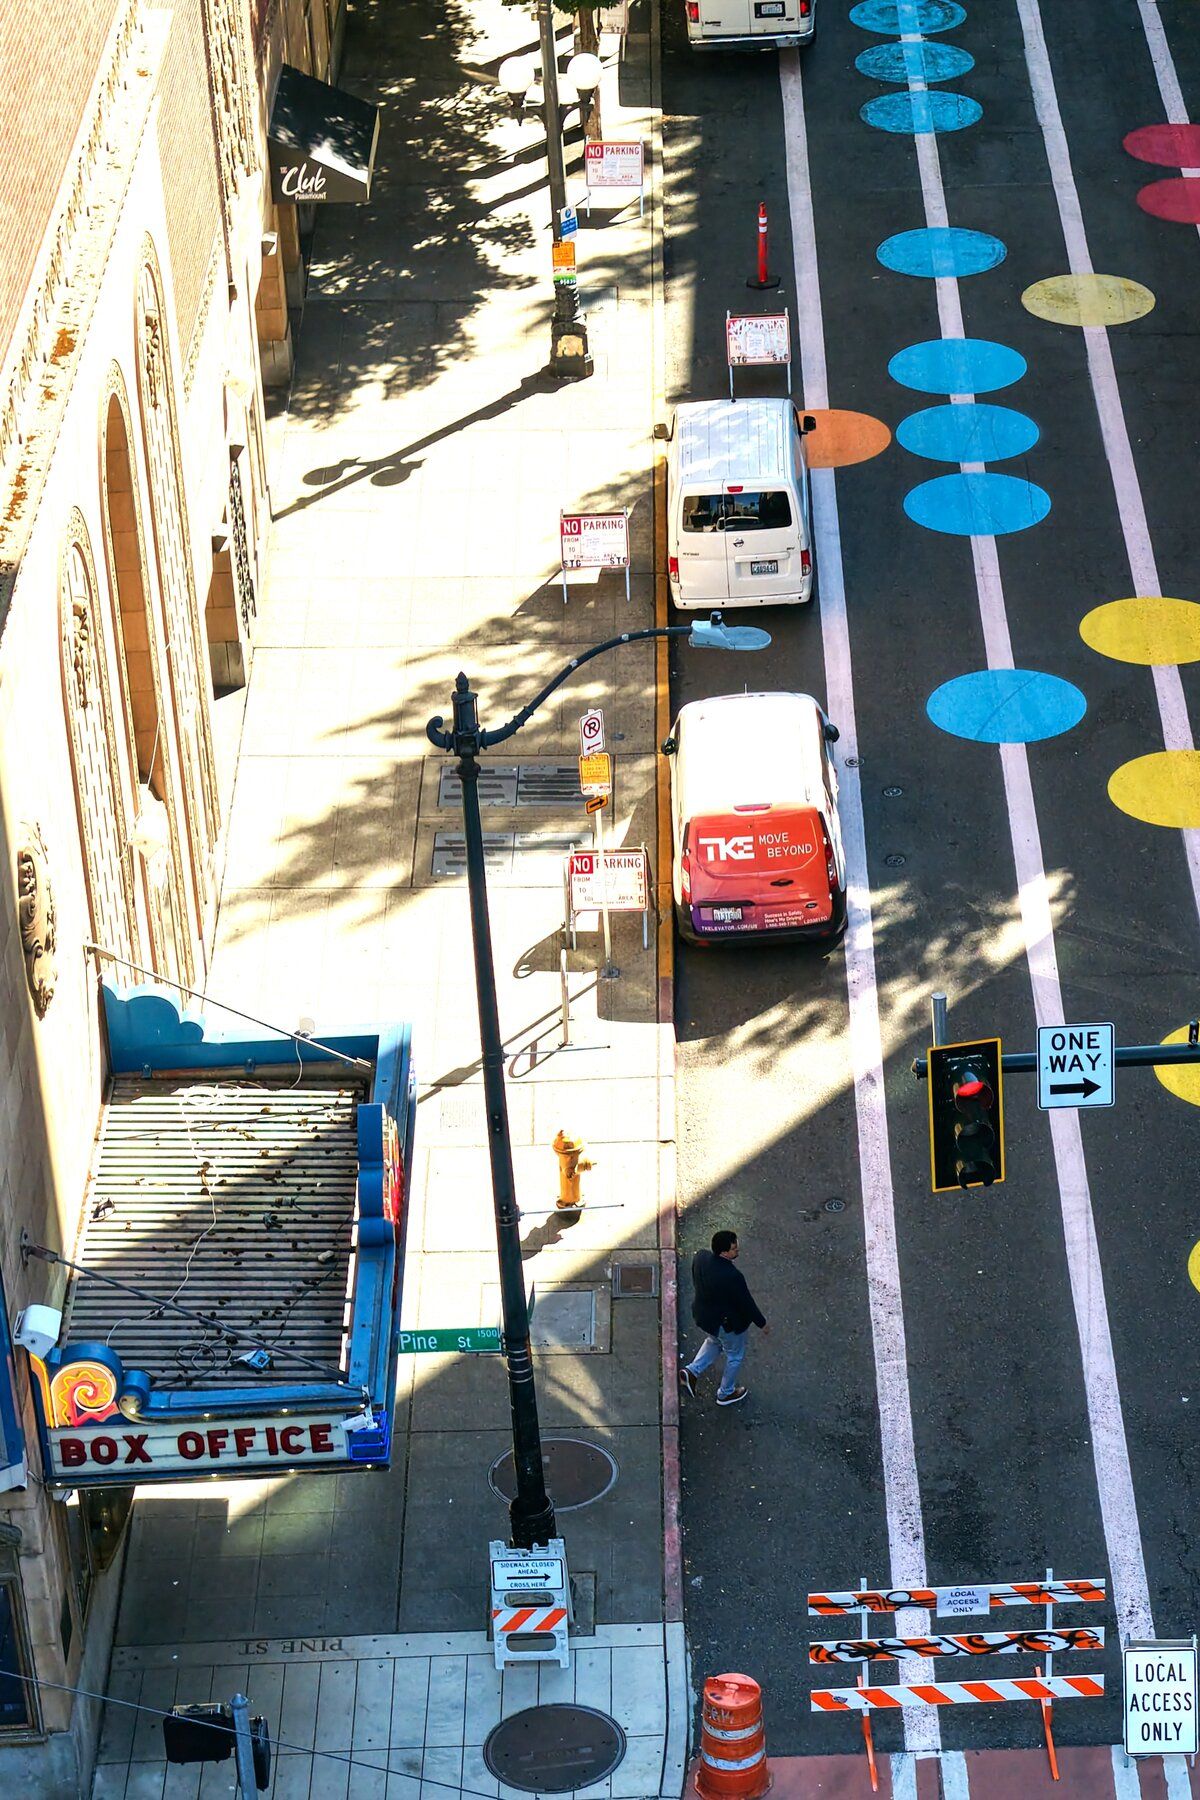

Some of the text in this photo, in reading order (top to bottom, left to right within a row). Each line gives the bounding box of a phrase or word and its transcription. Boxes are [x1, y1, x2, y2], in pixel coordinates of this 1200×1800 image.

[588, 146, 640, 157] NO PARKING
[281, 162, 327, 196] Club
[563, 520, 624, 534] NO PARKING
[562, 560, 581, 568] STG
[758, 832, 790, 845] MOVE
[698, 835, 756, 862] TKE
[767, 843, 813, 858] BEYOND
[574, 857, 590, 872] NO
[701, 924, 758, 932] TKELEVATOR.COM/US
[1051, 1031, 1100, 1050] ONE
[1049, 1053, 1102, 1073] WAY
[400, 1333, 472, 1350] Pine St
[477, 1329, 498, 1338] 1500
[59, 1423, 335, 1467] BOX OFFICE
[239, 1638, 344, 1656] PINE ST
[1135, 1663, 1187, 1682] LOCAL
[1129, 1692, 1192, 1712] ACCESS
[1141, 1722, 1183, 1741] ONLY
